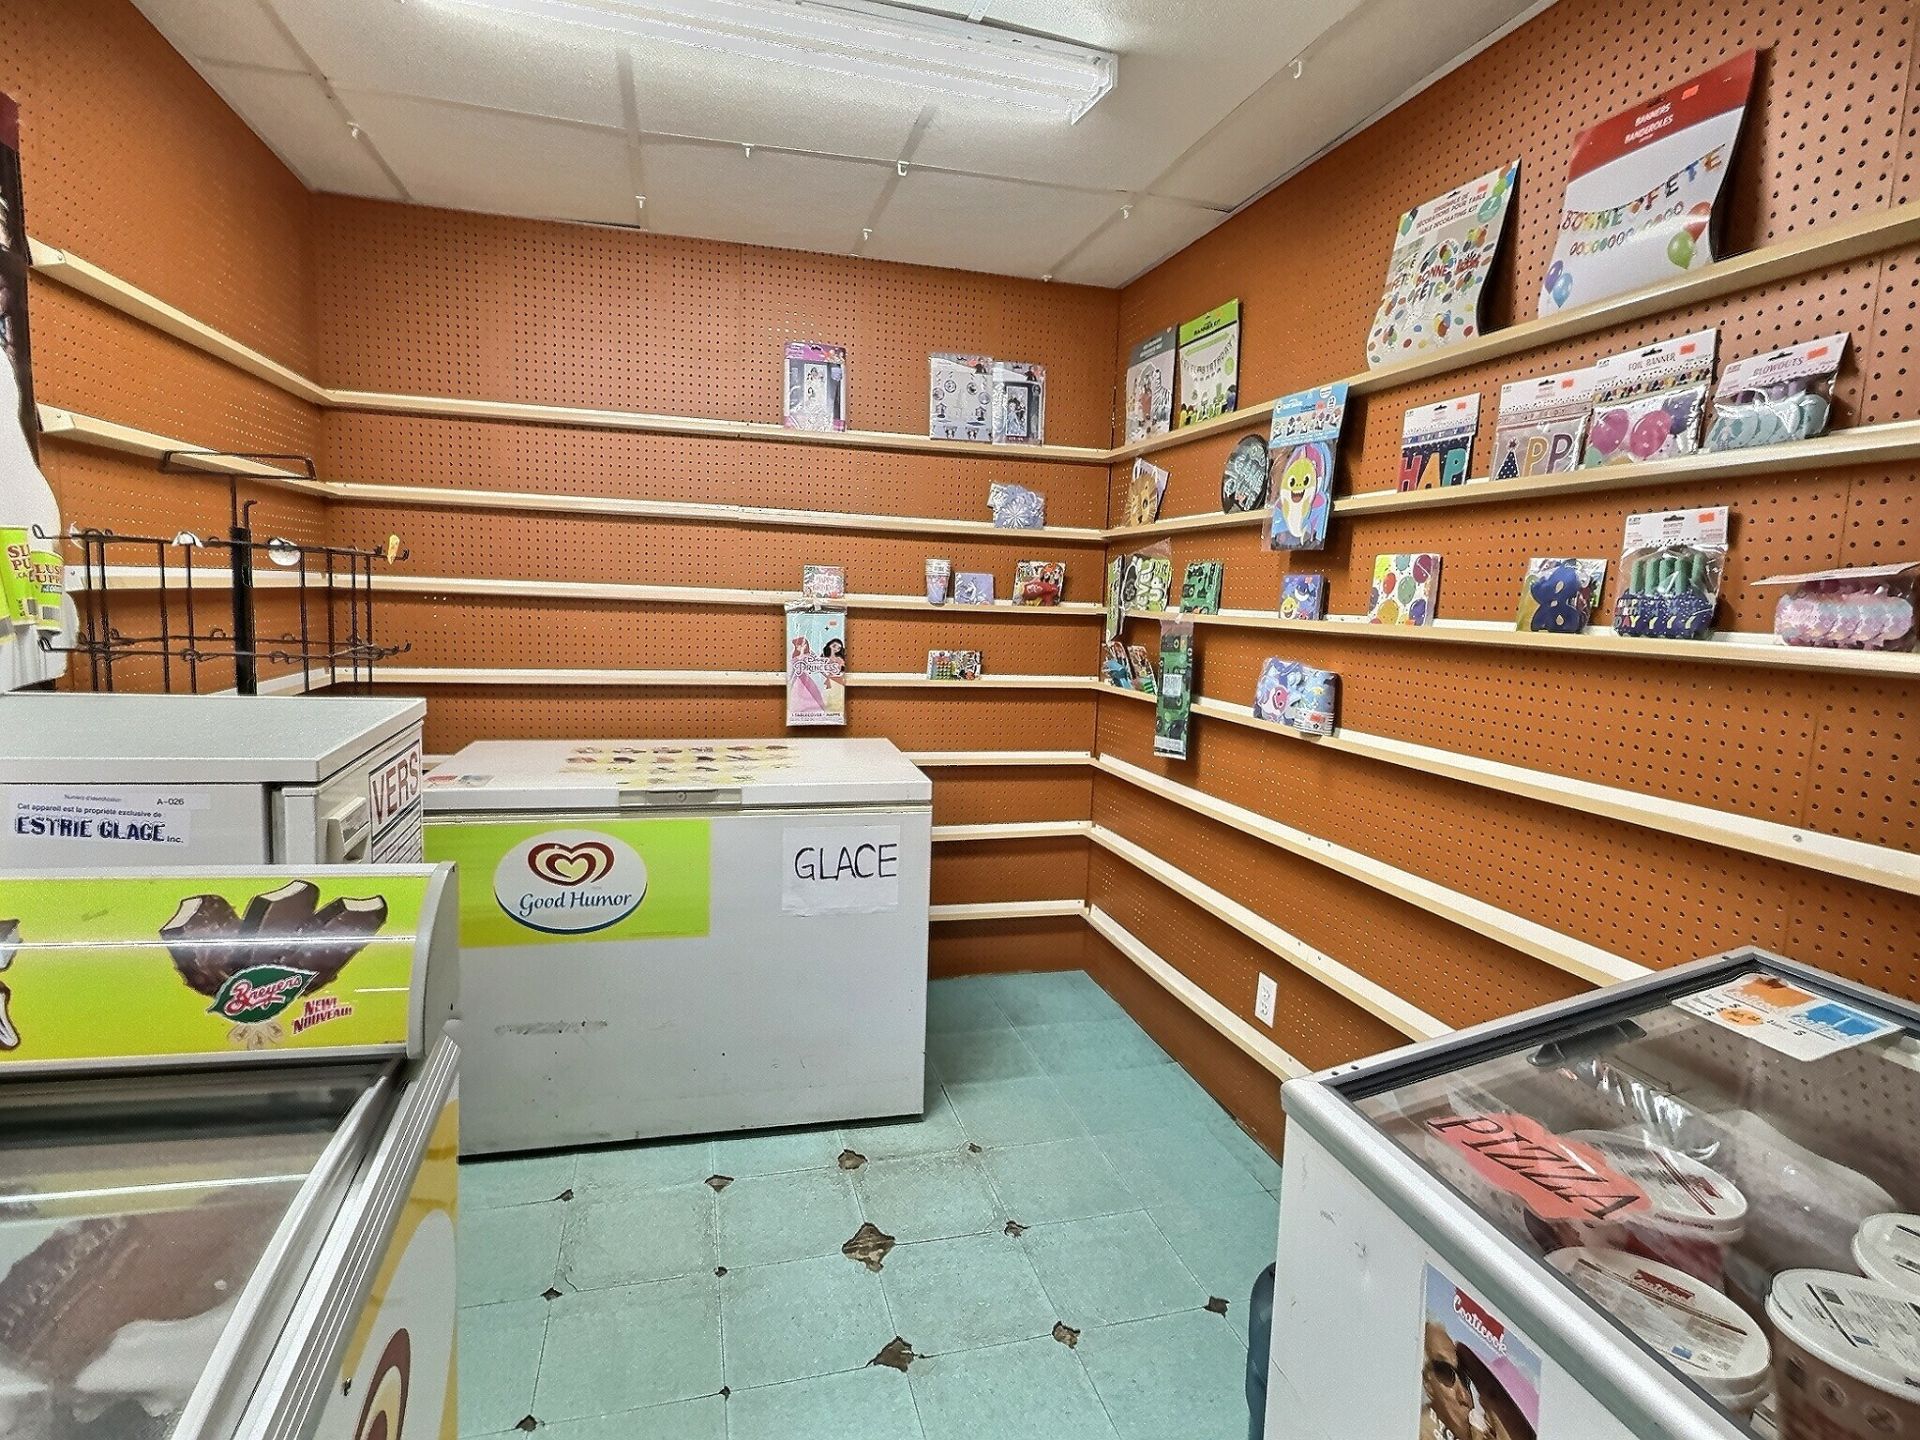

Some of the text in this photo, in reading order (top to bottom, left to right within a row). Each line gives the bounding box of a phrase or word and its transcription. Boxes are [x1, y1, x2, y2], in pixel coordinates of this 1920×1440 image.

[32, 805, 61, 813] appareil
[119, 810, 151, 818] exclusive
[157, 798, 184, 806] A-026
[16, 816, 92, 839] ESTRIE
[794, 843, 898, 881] GLACE
[519, 891, 632, 917] Good Humor
[224, 974, 303, 1016] Breyers
[1427, 1116, 1641, 1219] PIZZA
[1453, 1294, 1508, 1353] Coaticook
